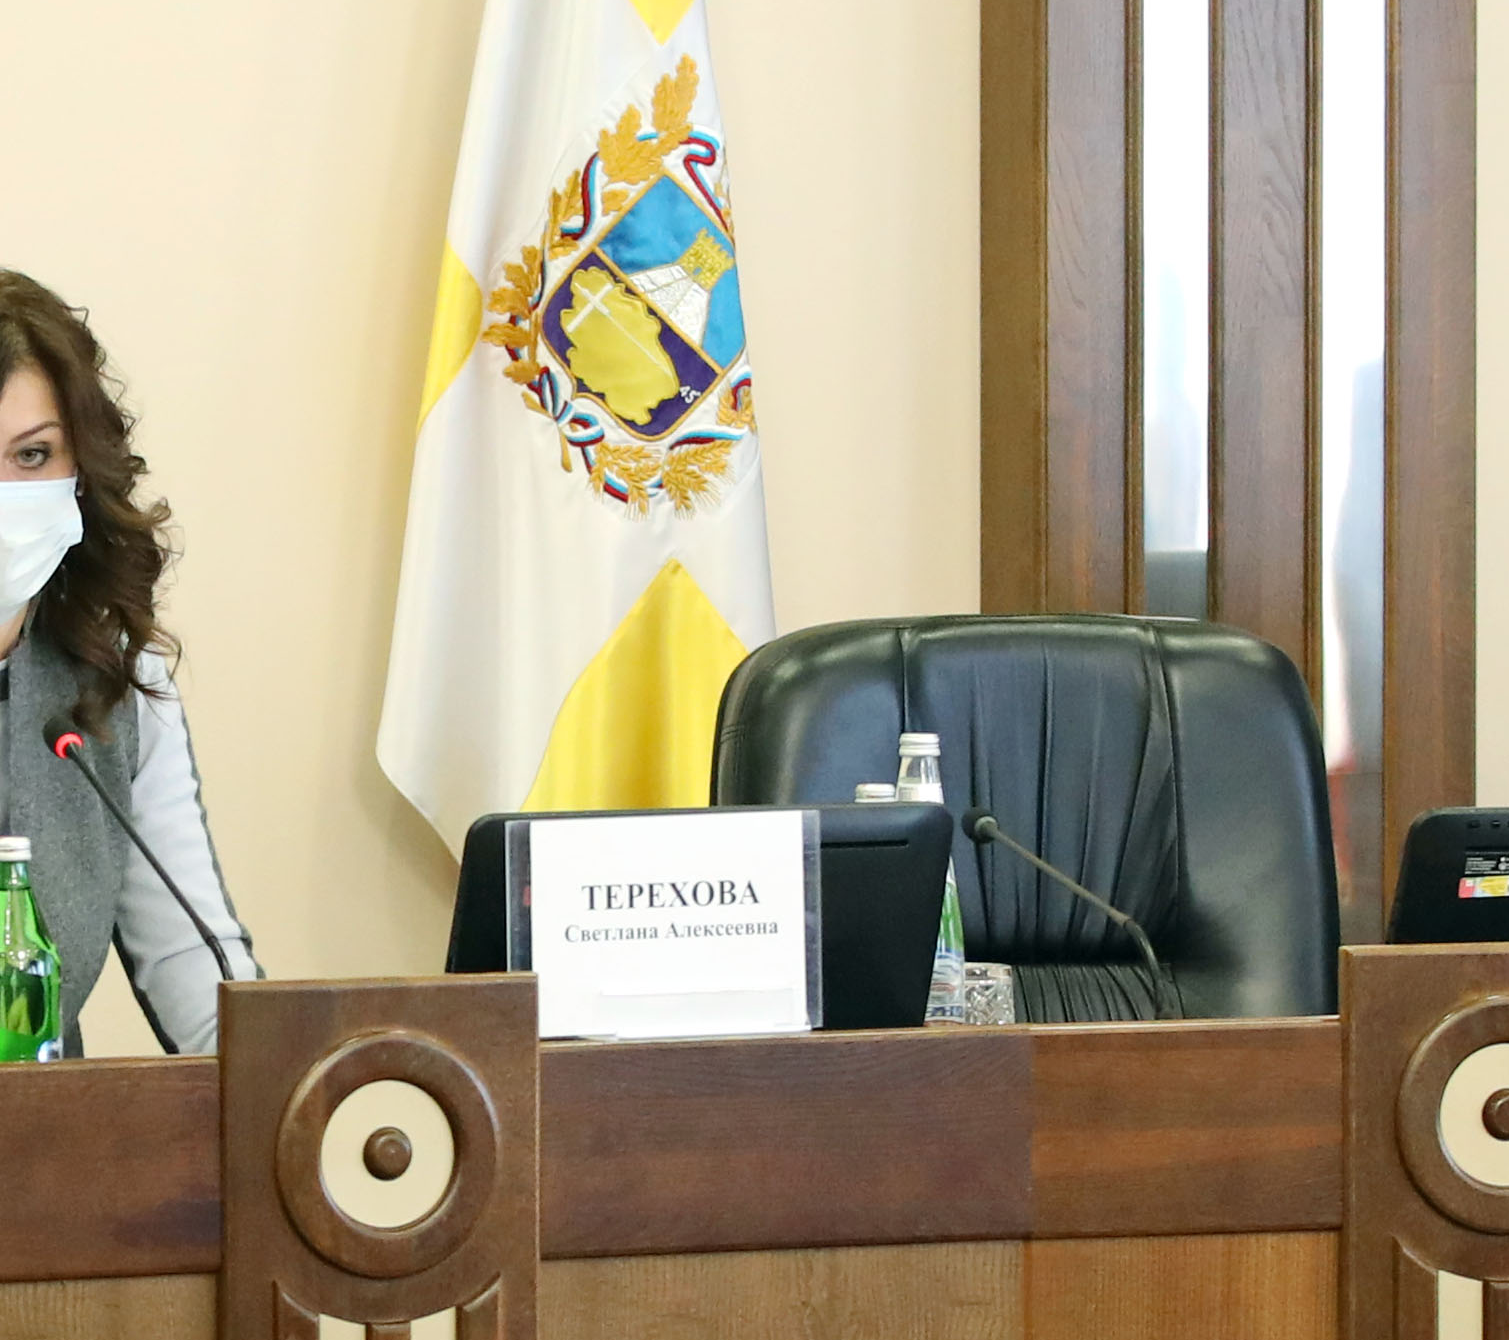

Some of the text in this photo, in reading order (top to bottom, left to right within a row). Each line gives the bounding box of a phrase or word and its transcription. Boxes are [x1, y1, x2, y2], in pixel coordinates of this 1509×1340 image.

[581, 878, 761, 911] ТЕРЕХОВА
[564, 920, 780, 943] Светлана Алексеевна
